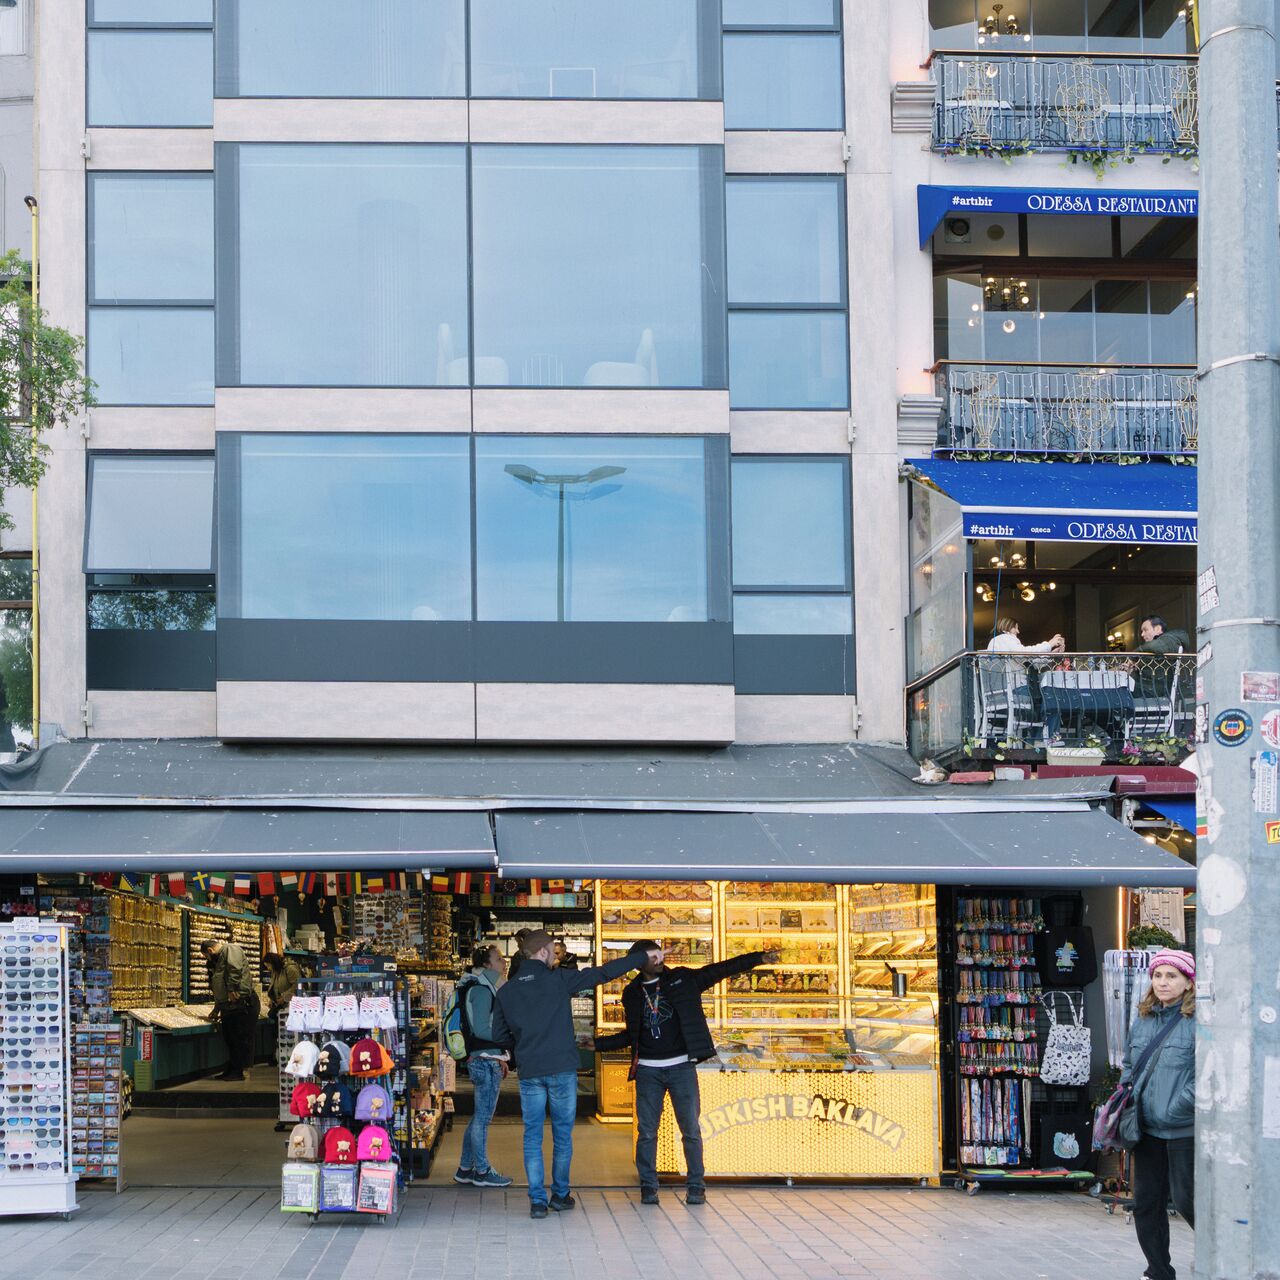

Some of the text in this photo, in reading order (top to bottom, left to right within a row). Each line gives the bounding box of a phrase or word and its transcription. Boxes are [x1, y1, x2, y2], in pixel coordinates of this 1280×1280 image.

[1027, 195, 1093, 211] ODESSA
[1098, 197, 1196, 214] RESTAURANT
[1067, 522, 1137, 539] ODESSA
[701, 1096, 903, 1150] URKISH BAKLAVA
